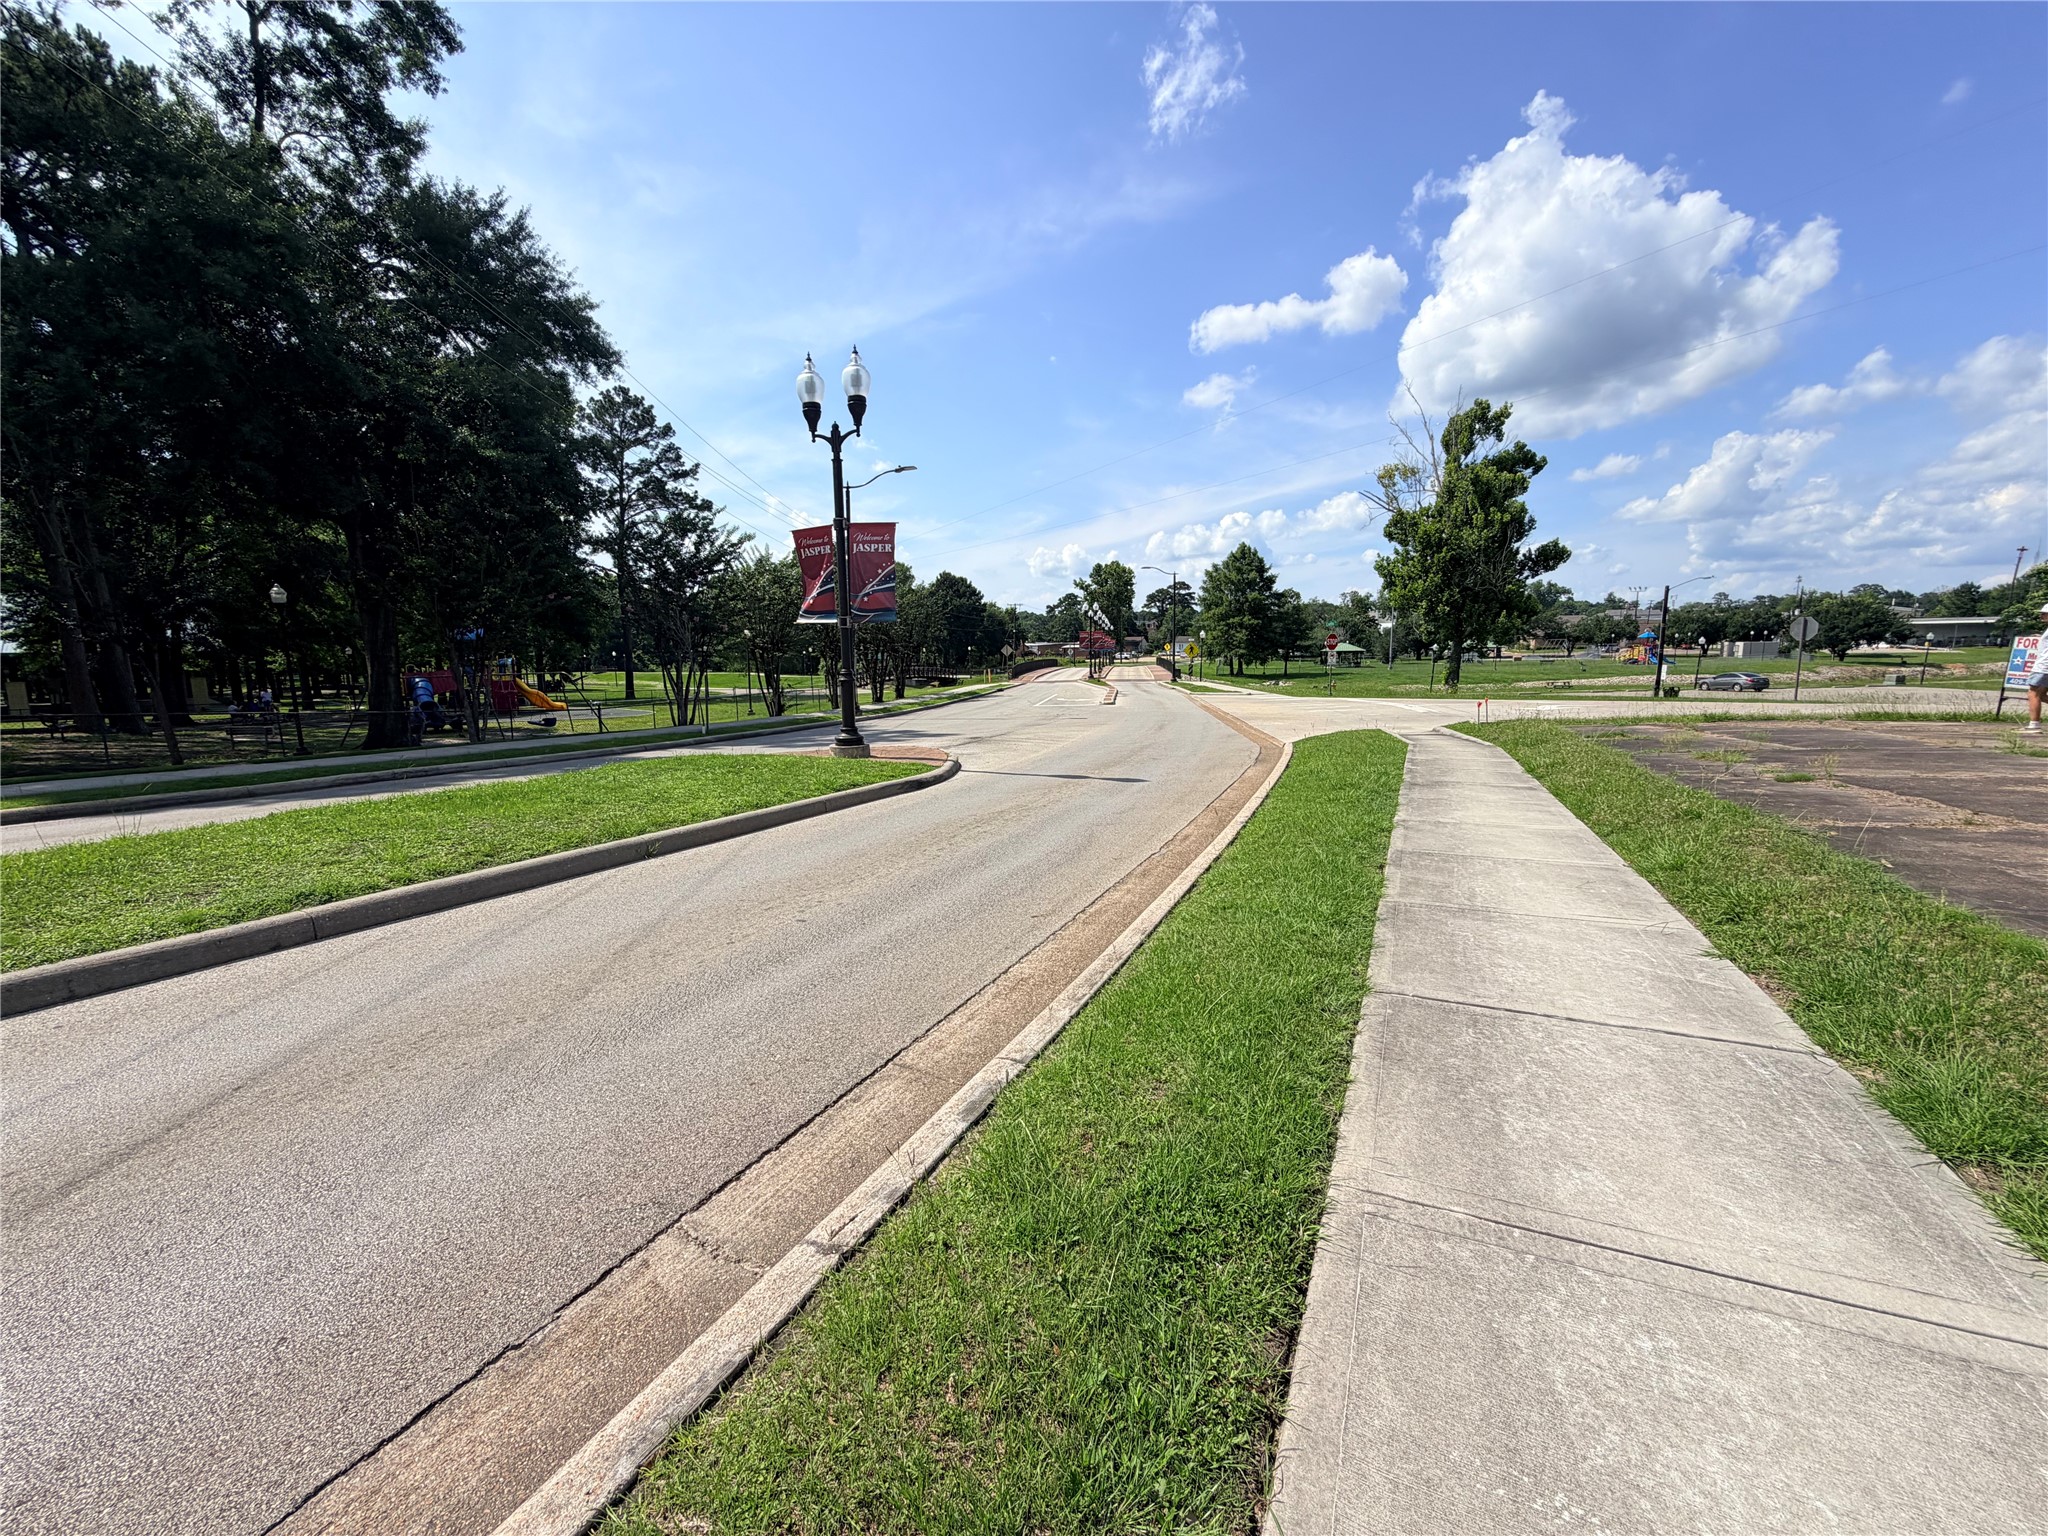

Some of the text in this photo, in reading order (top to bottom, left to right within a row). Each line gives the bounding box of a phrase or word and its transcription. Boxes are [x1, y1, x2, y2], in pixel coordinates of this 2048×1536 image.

[798, 536, 823, 546] Welcome
[854, 532, 883, 541] Welcome
[800, 544, 831, 559] JASPER
[852, 543, 892, 553] JASPER
[2017, 638, 2039, 648] FOR
